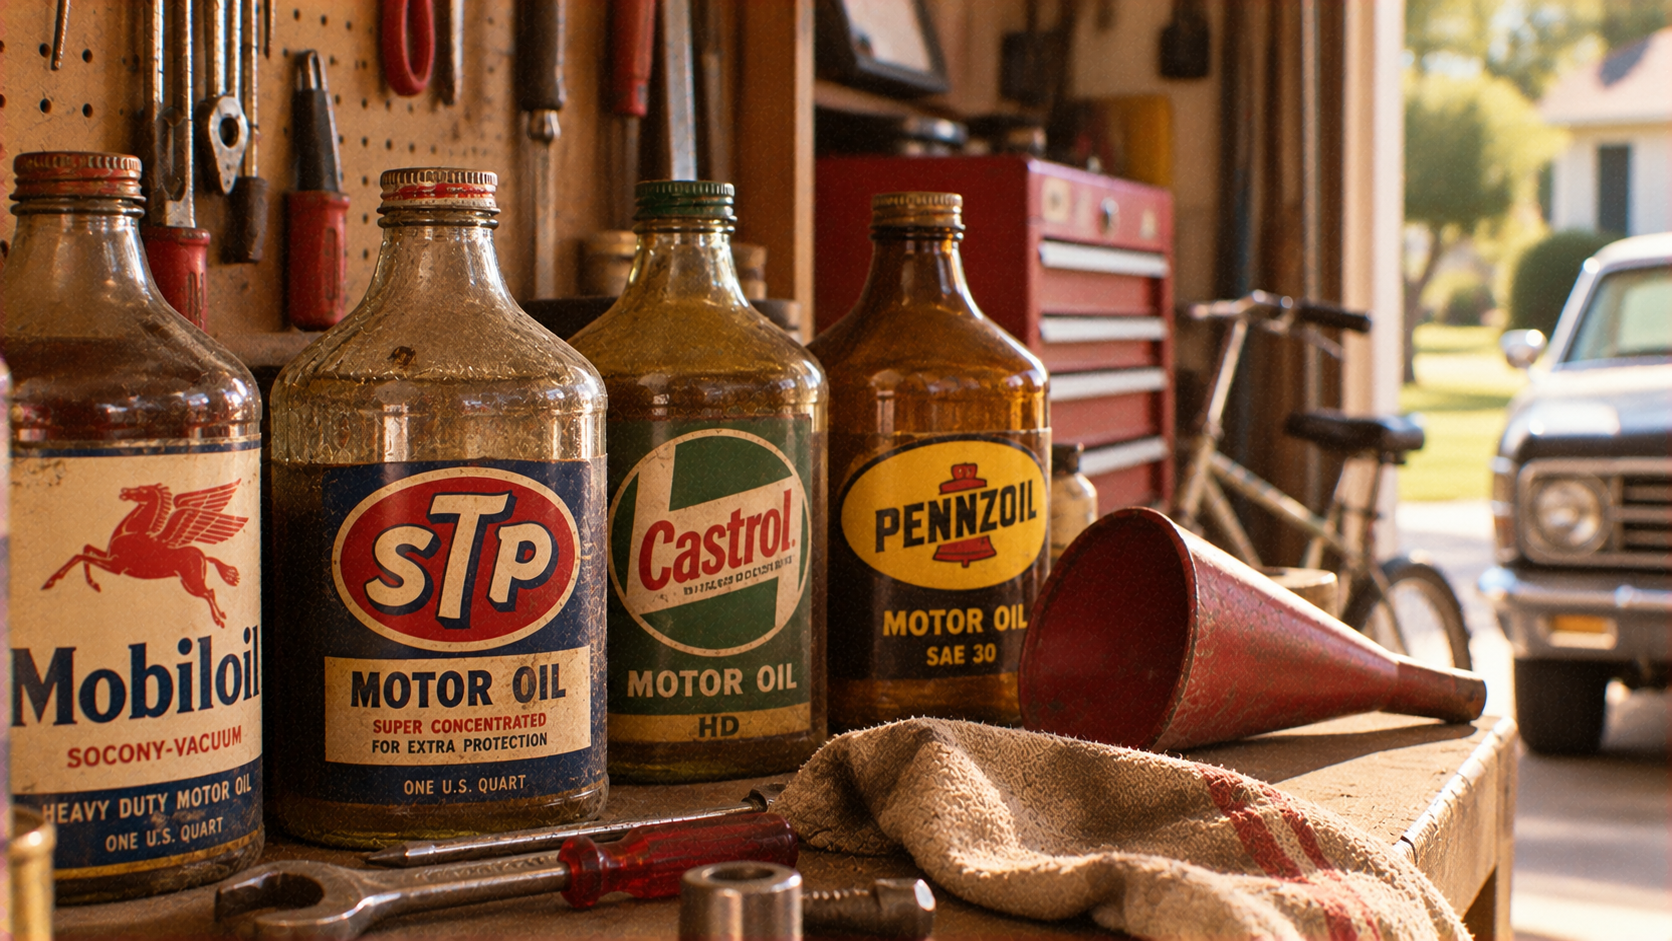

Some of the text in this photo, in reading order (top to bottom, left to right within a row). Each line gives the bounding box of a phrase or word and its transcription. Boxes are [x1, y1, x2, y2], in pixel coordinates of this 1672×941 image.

[875, 479, 1037, 553] PENNZOIL
[364, 490, 559, 630] STP
[883, 603, 1028, 636] MOTOR OIL
[926, 643, 997, 666] SAE 30
[11, 625, 260, 727] Mobiloil
[350, 663, 567, 710] MOTOR OIL
[627, 662, 797, 698] MOTOR OIL
[373, 712, 547, 735] SUPER CONCENTRATED
[699, 715, 740, 738] HD
[67, 725, 242, 769] SOCONY-VACUUM
[371, 732, 548, 754] FOR EXTRA PROTECTION
[42, 773, 252, 825] HEAVY DUTY MOTOR OIL
[404, 774, 526, 795] ONE U.S. QUART
[106, 816, 223, 852] ONE U.S. QUART
